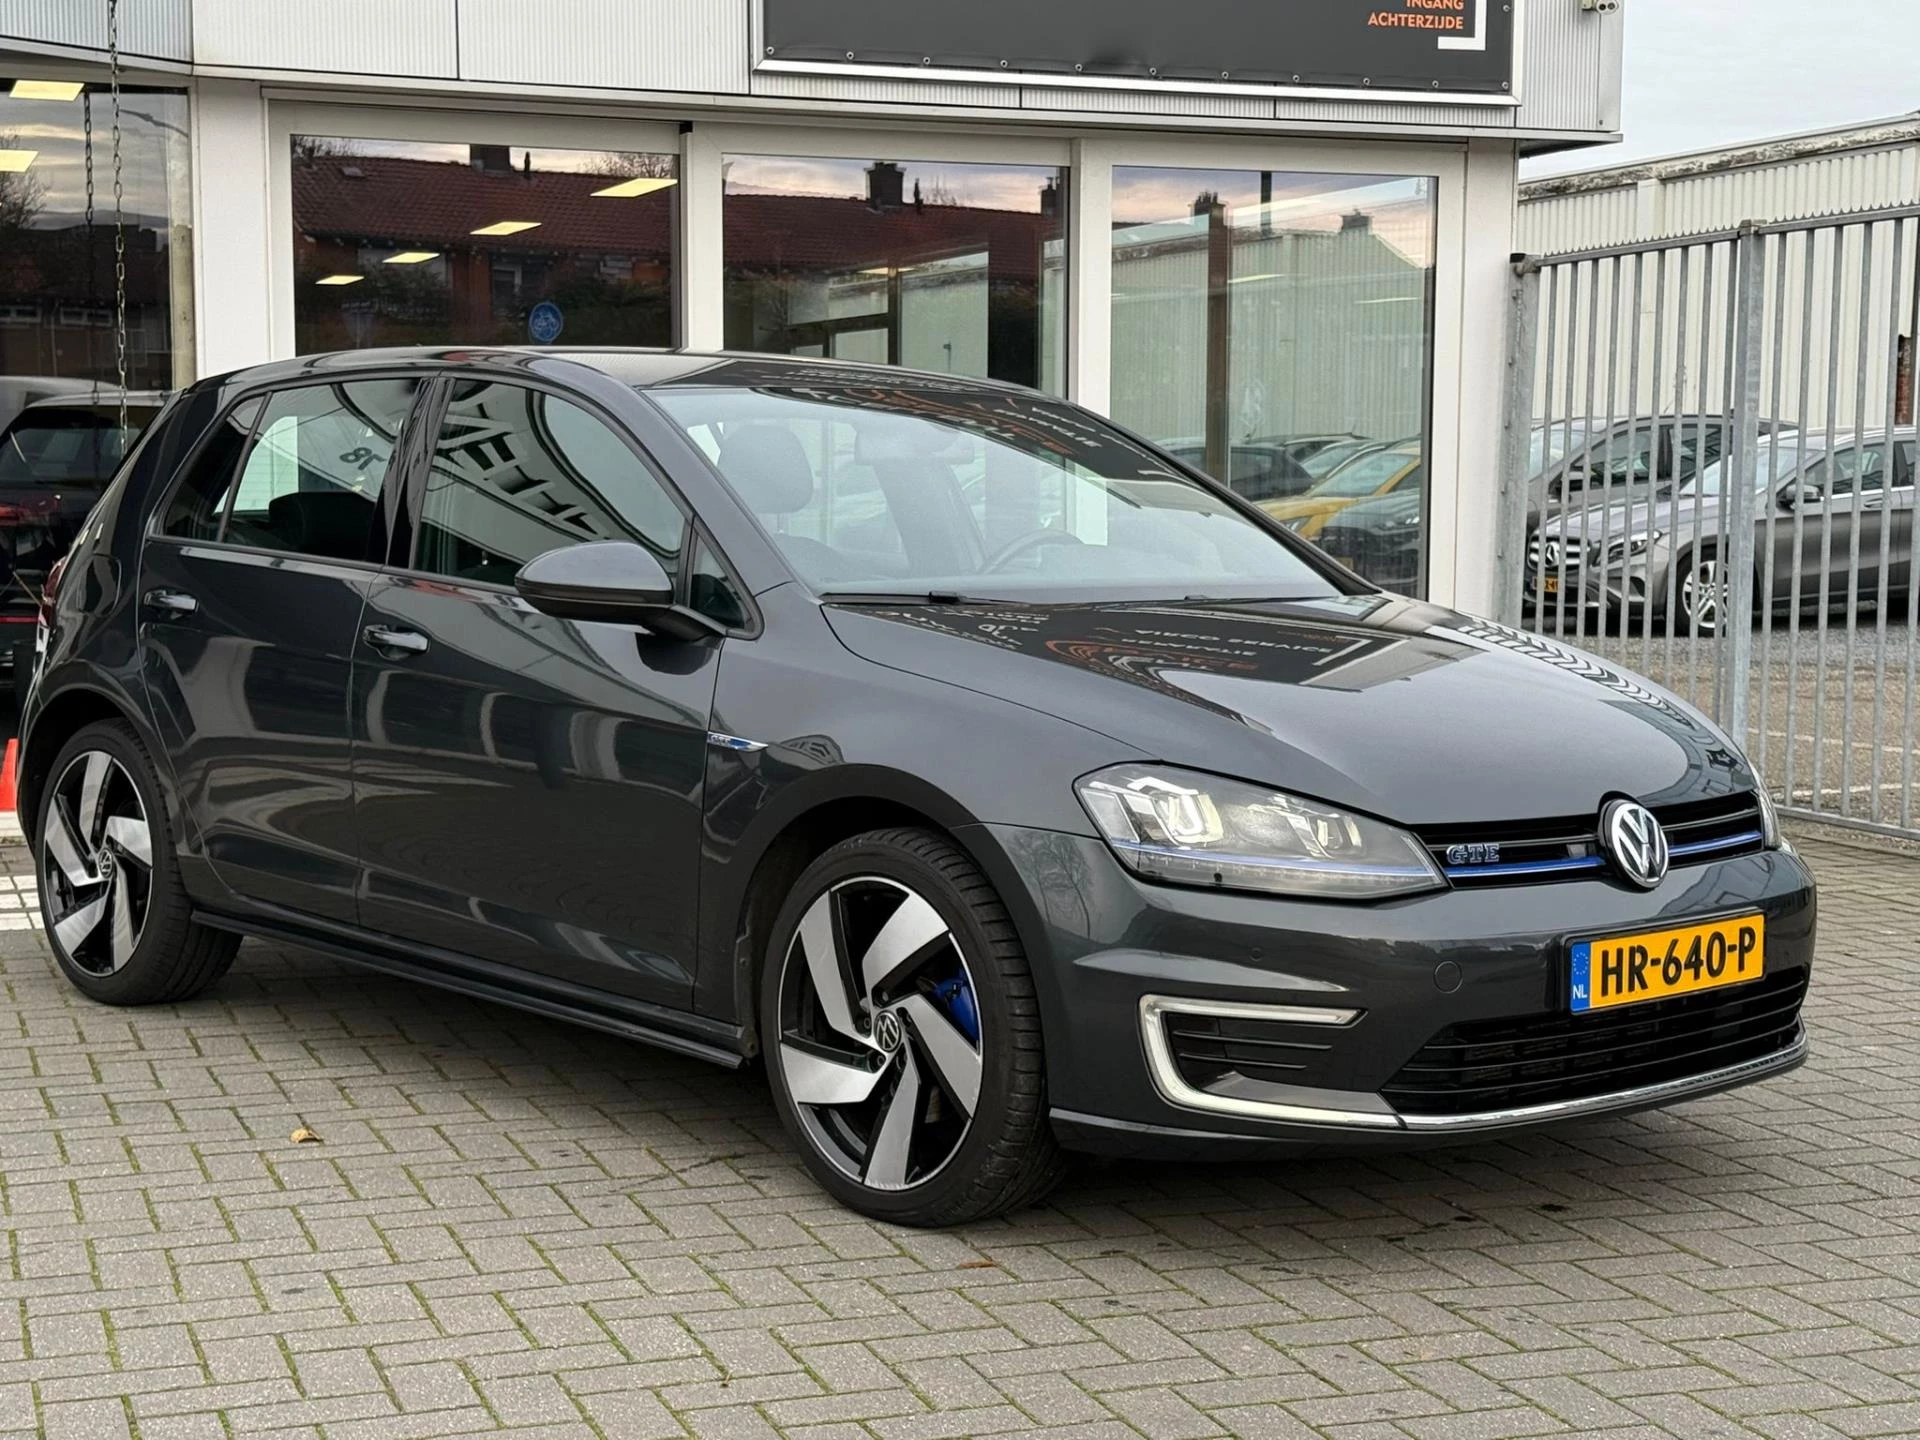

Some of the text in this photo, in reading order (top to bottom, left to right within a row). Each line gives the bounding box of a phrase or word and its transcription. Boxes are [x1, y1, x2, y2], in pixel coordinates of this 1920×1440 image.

[1406, 0, 1464, 10] INGANG
[1367, 12, 1464, 30] ACHTERZIJDE
[1446, 843, 1500, 864] GTE
[1601, 926, 1756, 997] HR-640-P
[1572, 984, 1588, 999] NL
